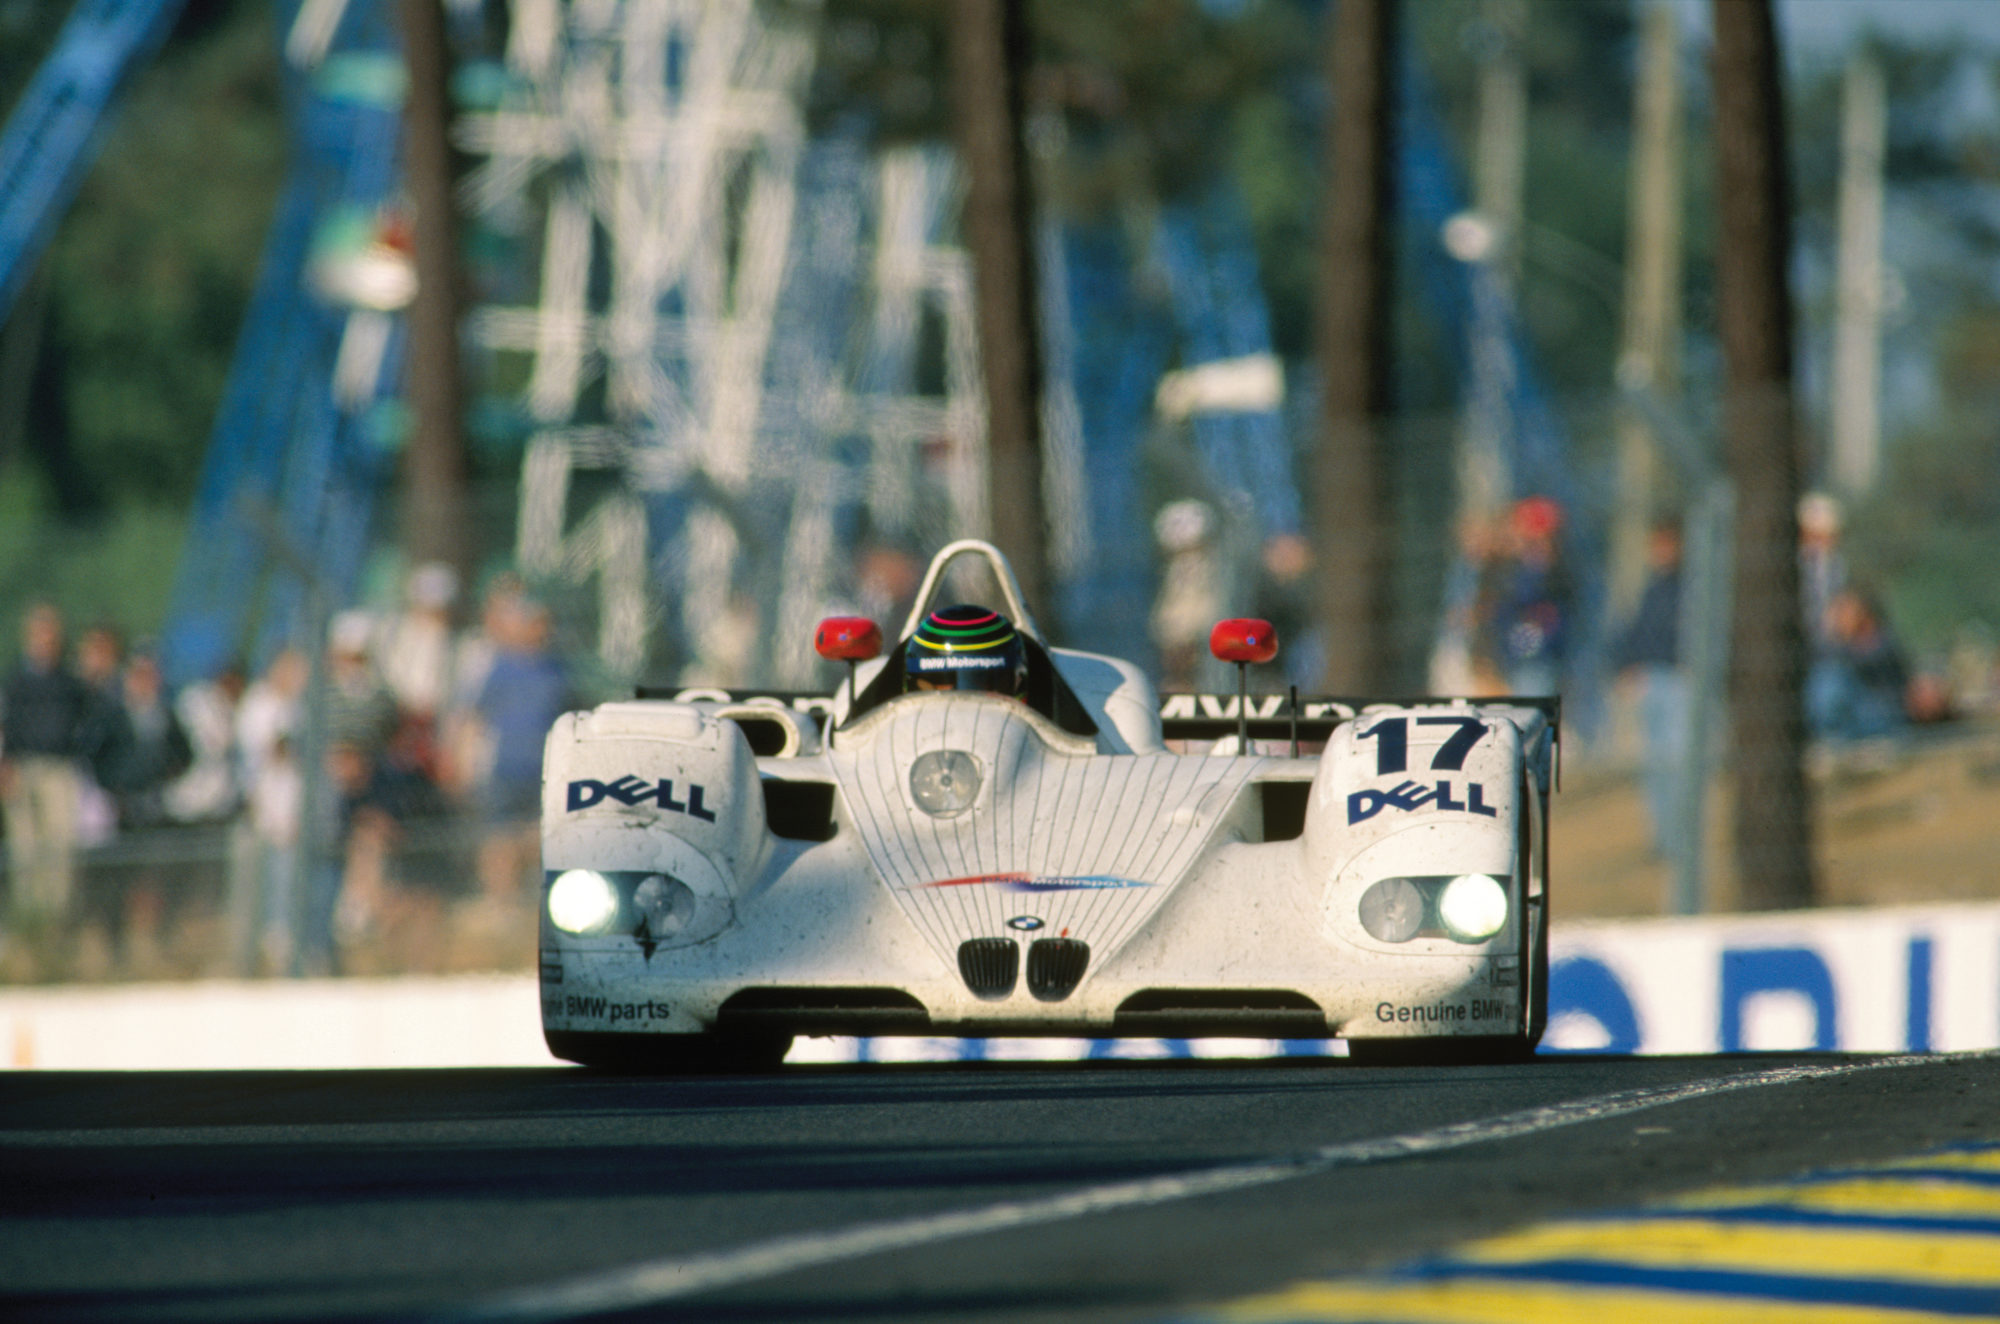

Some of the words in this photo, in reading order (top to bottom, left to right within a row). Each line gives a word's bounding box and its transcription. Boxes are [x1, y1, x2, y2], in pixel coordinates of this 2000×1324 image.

[919, 657, 945, 670] BMW
[947, 656, 1005, 669] Motorsport
[1357, 717, 1488, 775] 17
[567, 774, 716, 823] DELL
[1347, 780, 1497, 826] DELL
[565, 996, 607, 1018] BMW
[610, 1000, 670, 1024] parts
[1375, 1000, 1466, 1022] Genuine
[1471, 1000, 1504, 1020] BMW
